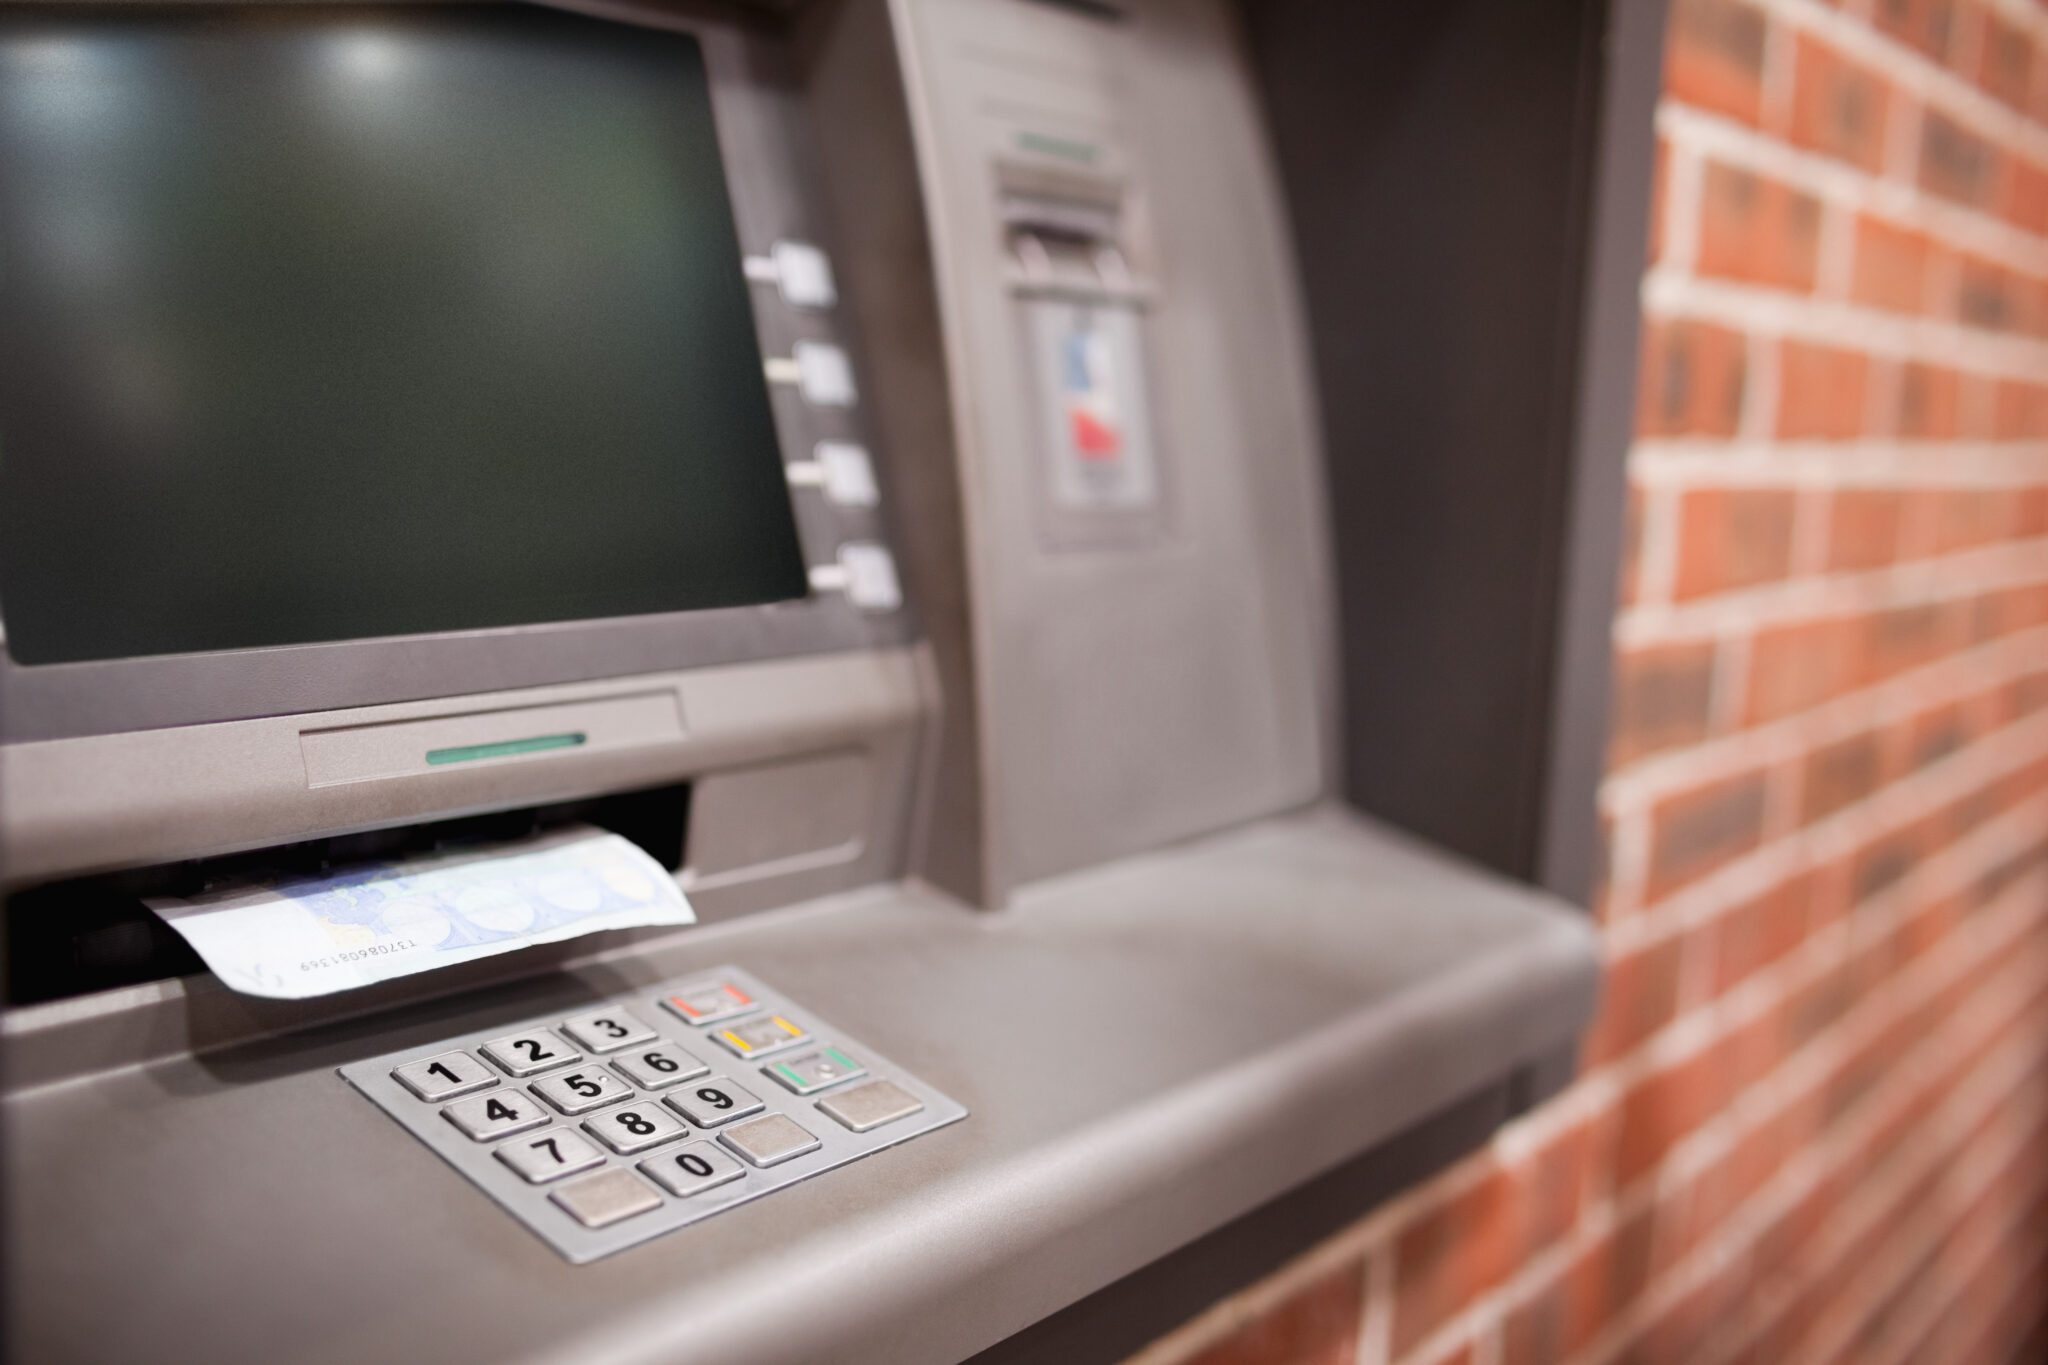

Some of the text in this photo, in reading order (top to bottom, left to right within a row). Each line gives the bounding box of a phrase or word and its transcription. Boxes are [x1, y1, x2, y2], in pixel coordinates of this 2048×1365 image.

[593, 1019, 629, 1038] 3
[513, 1040, 554, 1062] 2
[428, 1063, 462, 1084] 1
[643, 1053, 679, 1072] 6
[564, 1074, 602, 1097] 5
[486, 1097, 519, 1121] 4
[696, 1088, 734, 1109] 9
[616, 1112, 656, 1135] 8
[530, 1138, 564, 1164] 7
[675, 1154, 714, 1177] 0
